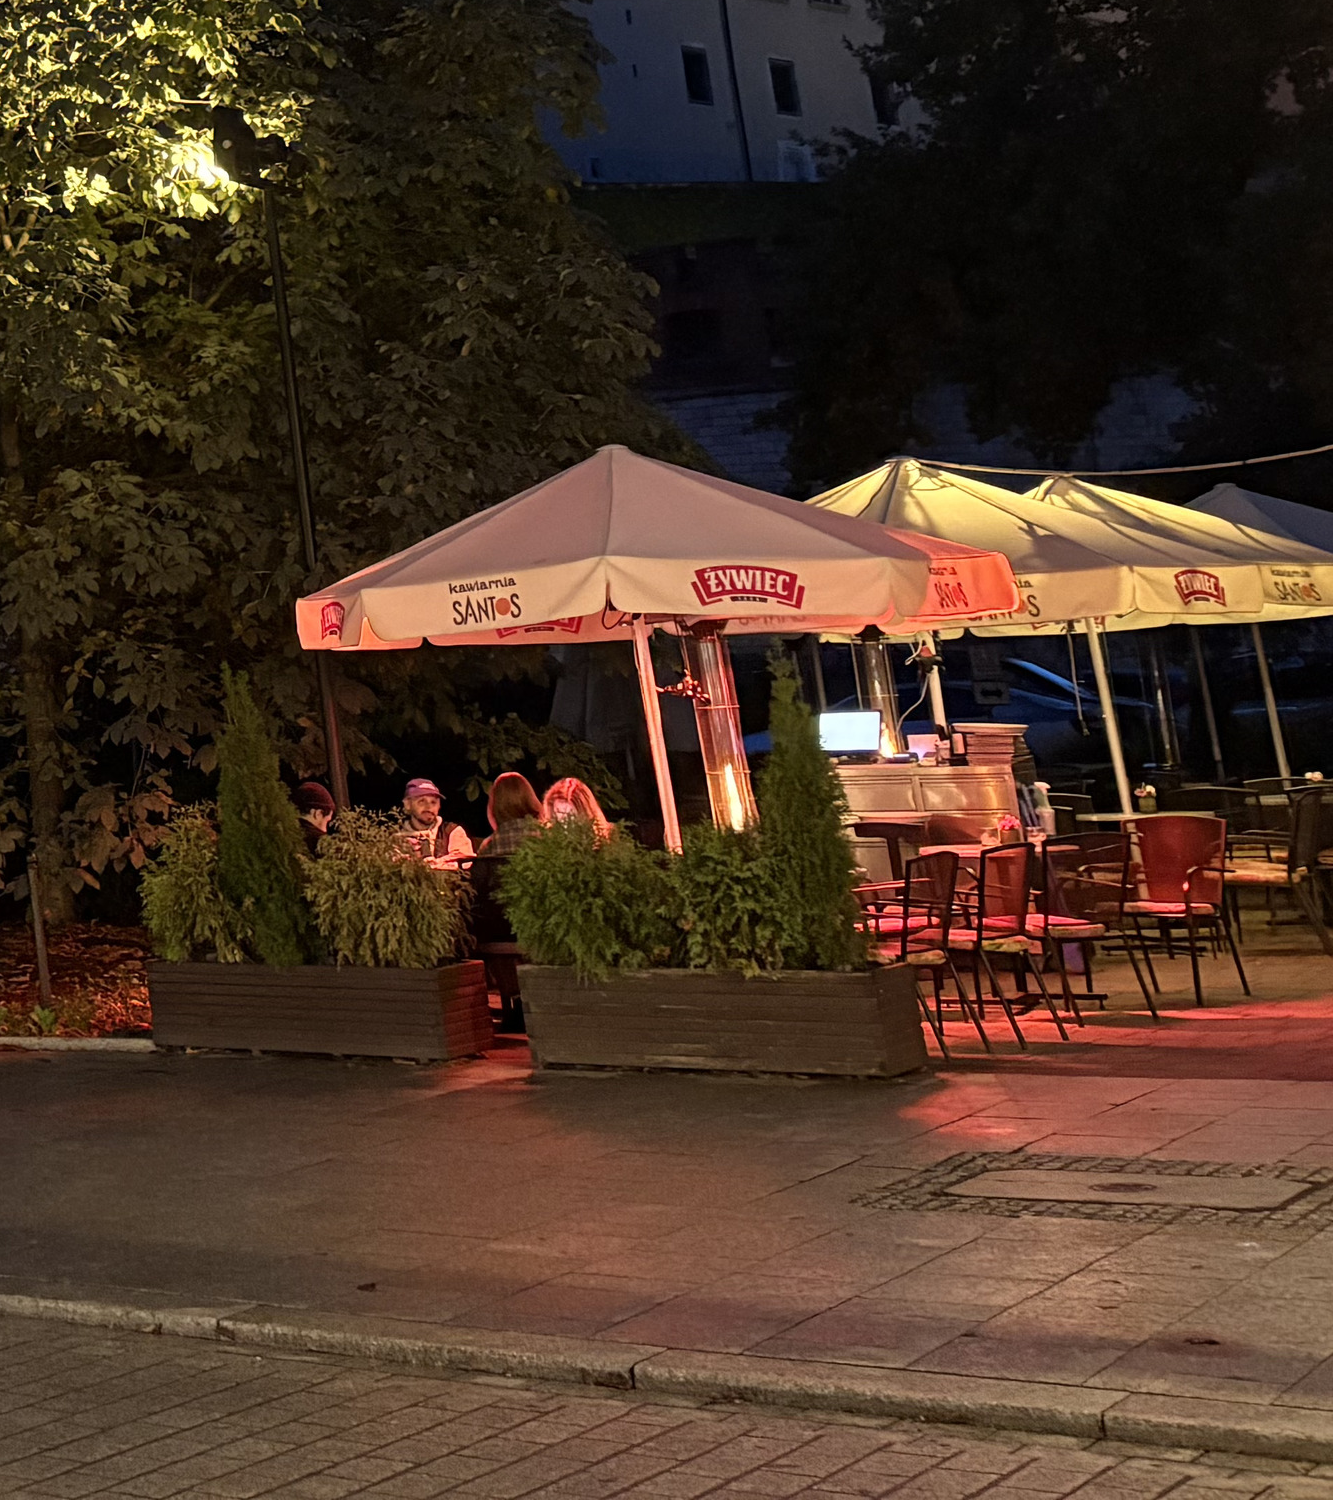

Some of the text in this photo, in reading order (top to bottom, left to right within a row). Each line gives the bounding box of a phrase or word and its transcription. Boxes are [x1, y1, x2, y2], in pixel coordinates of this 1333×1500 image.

[448, 577, 517, 594] kawiarnia
[704, 568, 790, 596] ŻYWIEC
[452, 593, 522, 625] SANTOS
